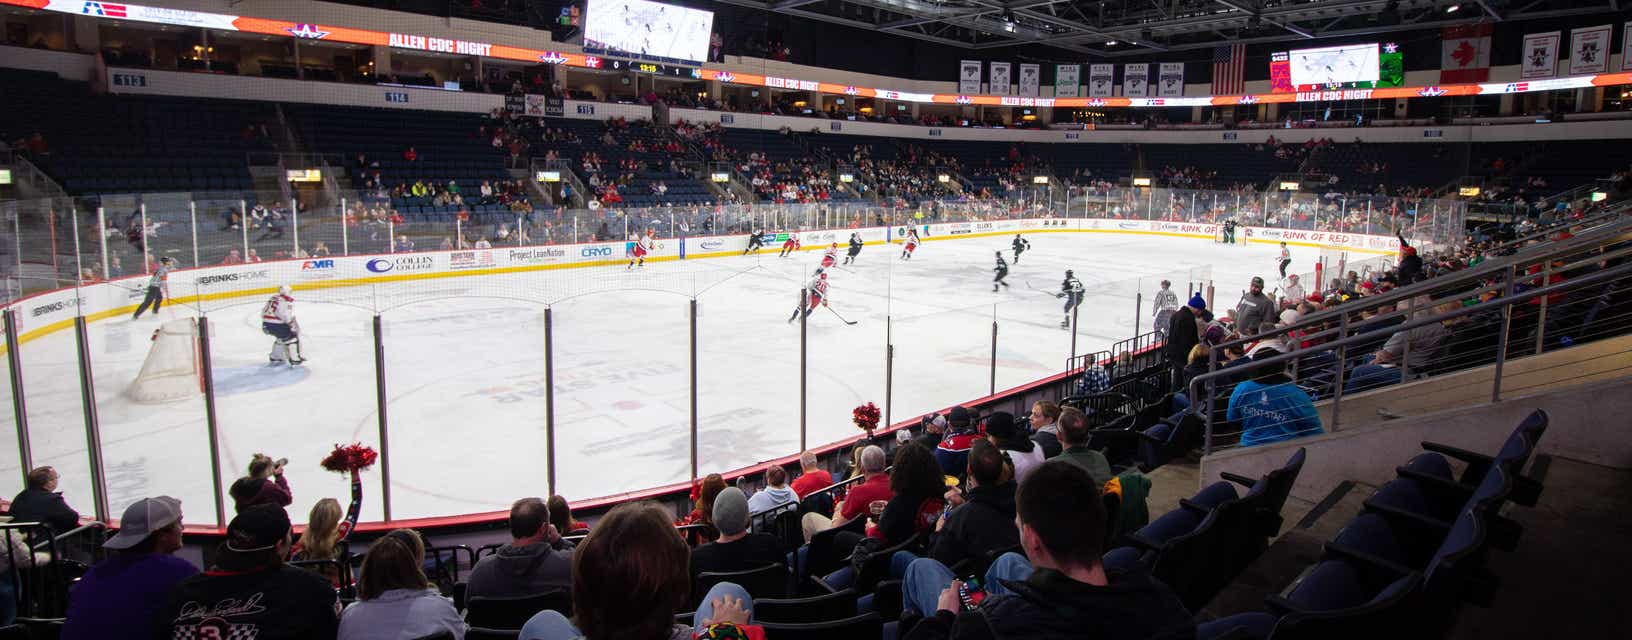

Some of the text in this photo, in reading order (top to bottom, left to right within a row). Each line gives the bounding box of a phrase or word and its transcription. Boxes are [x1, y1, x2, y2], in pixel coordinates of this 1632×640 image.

[389, 33, 492, 56] ALLEN CDC NIGHT
[765, 77, 818, 91] ALLEN CDC NIGHT
[1296, 89, 1373, 102] ALLEN CDC NIGHT
[1001, 97, 1019, 106] ALLEN
[1035, 98, 1055, 107] NIGHT
[1181, 224, 1201, 233] RINK
[1282, 231, 1307, 240] RINK
[1311, 233, 1325, 242] OF
[1329, 235, 1349, 243] RED
[510, 250, 533, 261] Project
[581, 247, 612, 257] CRYO
[396, 256, 433, 265] COLLIN
[396, 264, 432, 272] COLLEGE
[199, 270, 268, 285] BRINKS HOME
[33, 301, 63, 317] BRINKS
[200, 626, 222, 640] 3
